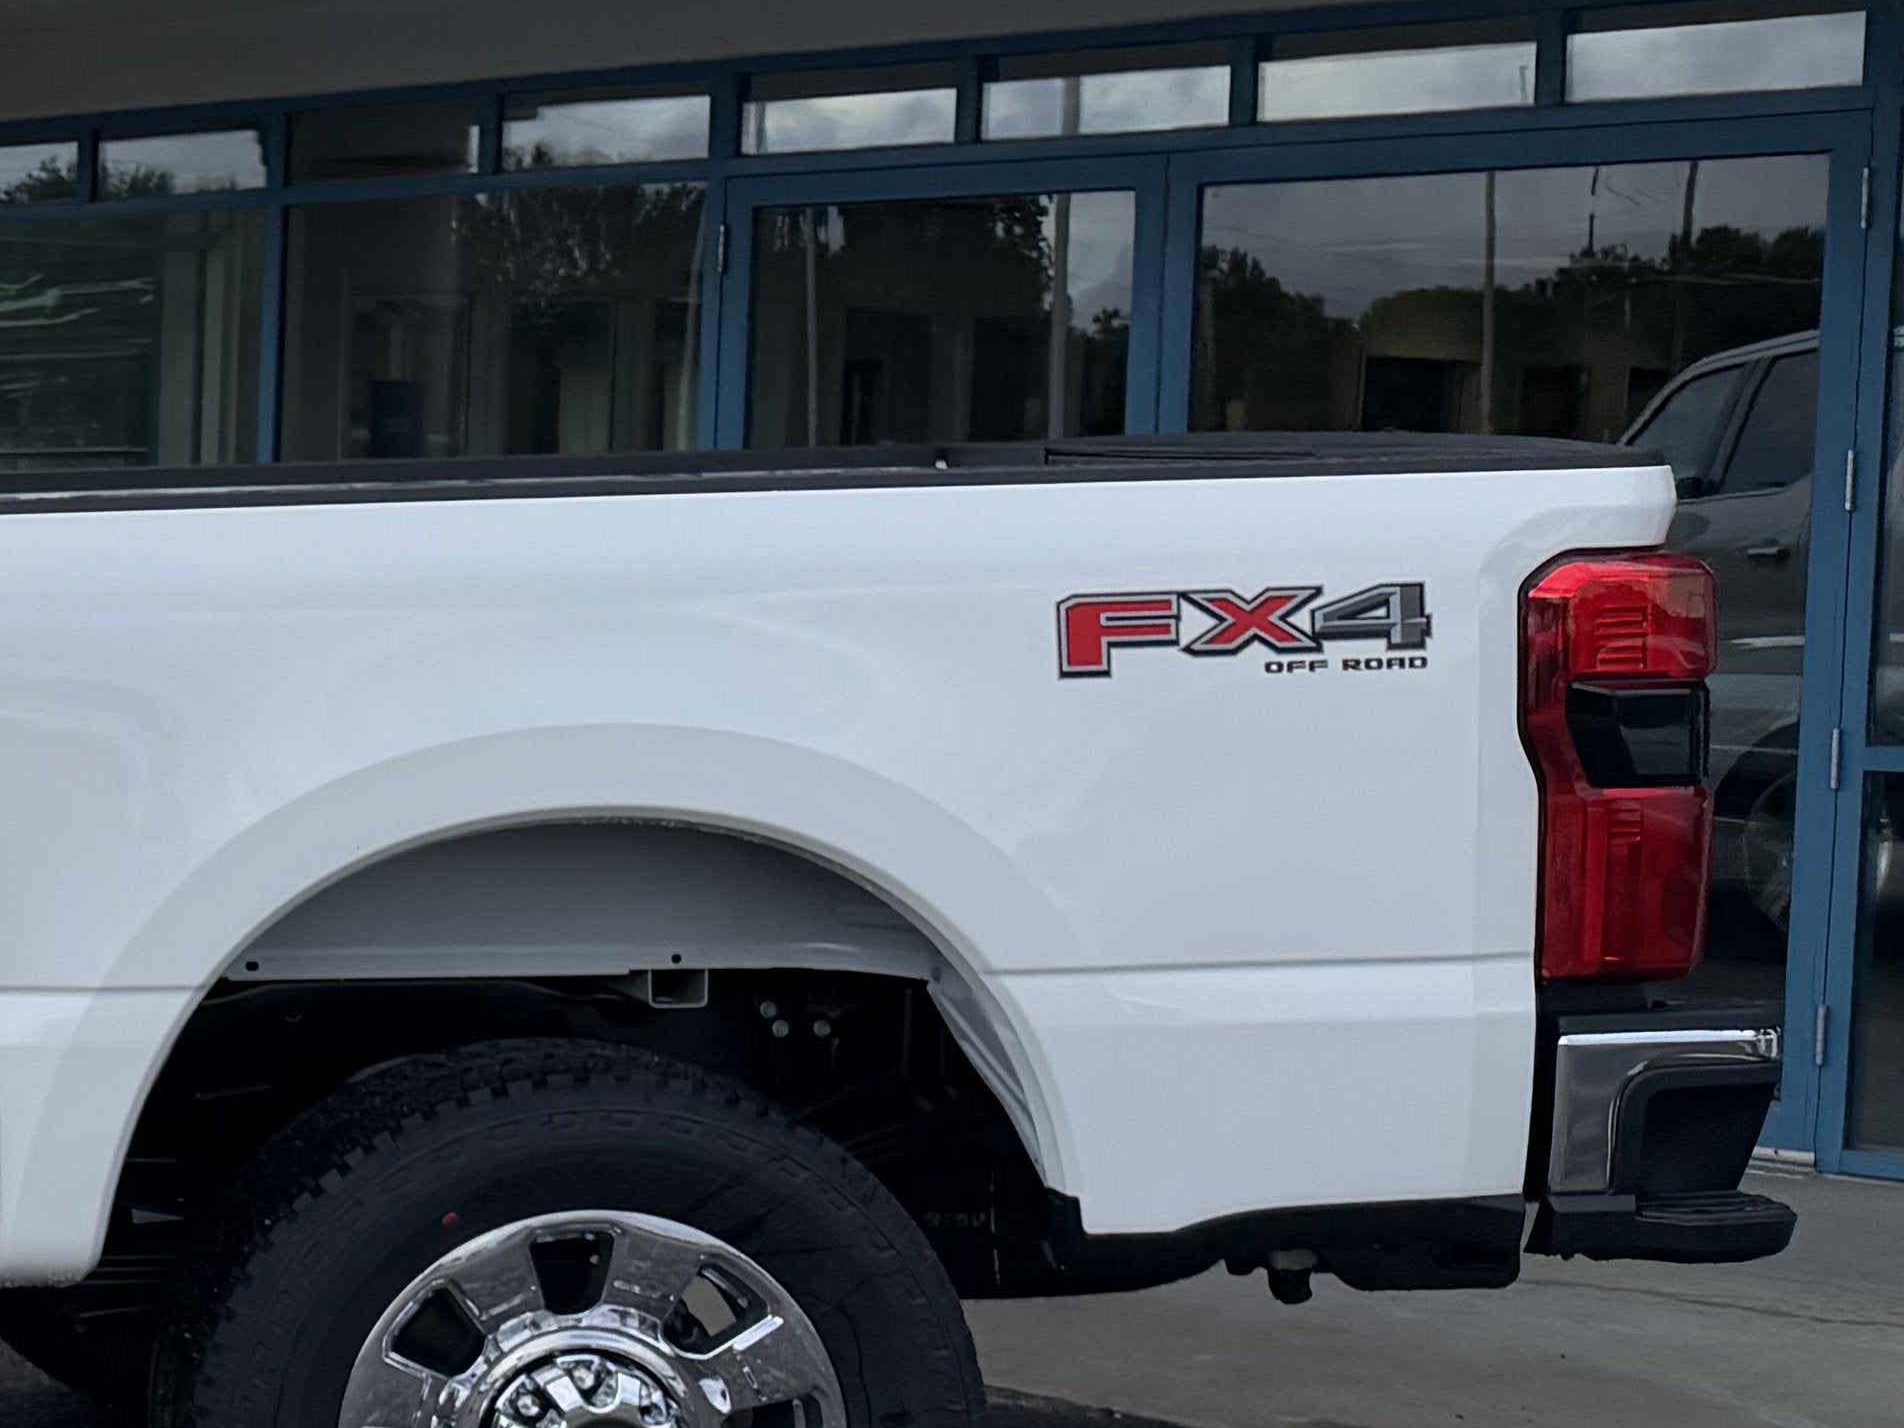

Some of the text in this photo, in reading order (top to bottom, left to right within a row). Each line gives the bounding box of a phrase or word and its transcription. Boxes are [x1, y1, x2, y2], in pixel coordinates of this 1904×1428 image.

[1057, 580, 1433, 679] FX4
[1263, 655, 1429, 674] OFF ROAD
